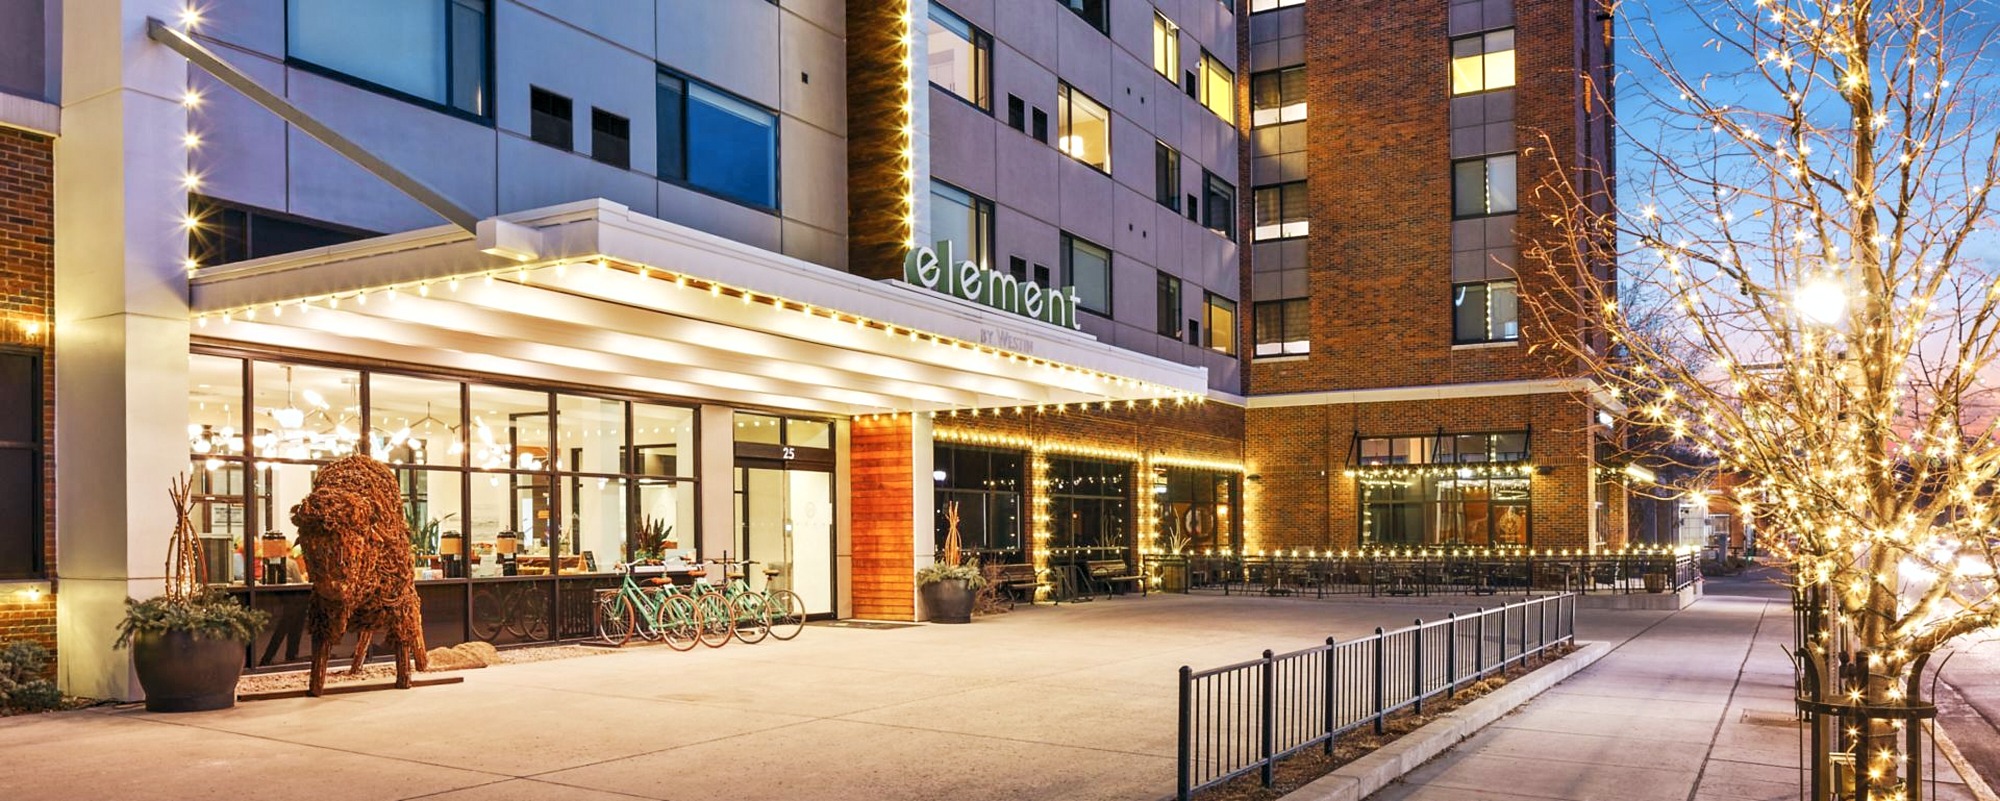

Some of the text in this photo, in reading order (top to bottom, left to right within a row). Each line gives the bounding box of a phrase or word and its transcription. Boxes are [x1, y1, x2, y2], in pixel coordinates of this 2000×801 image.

[913, 240, 1081, 331] element
[980, 328, 994, 344] BY
[783, 447, 795, 460] 25
